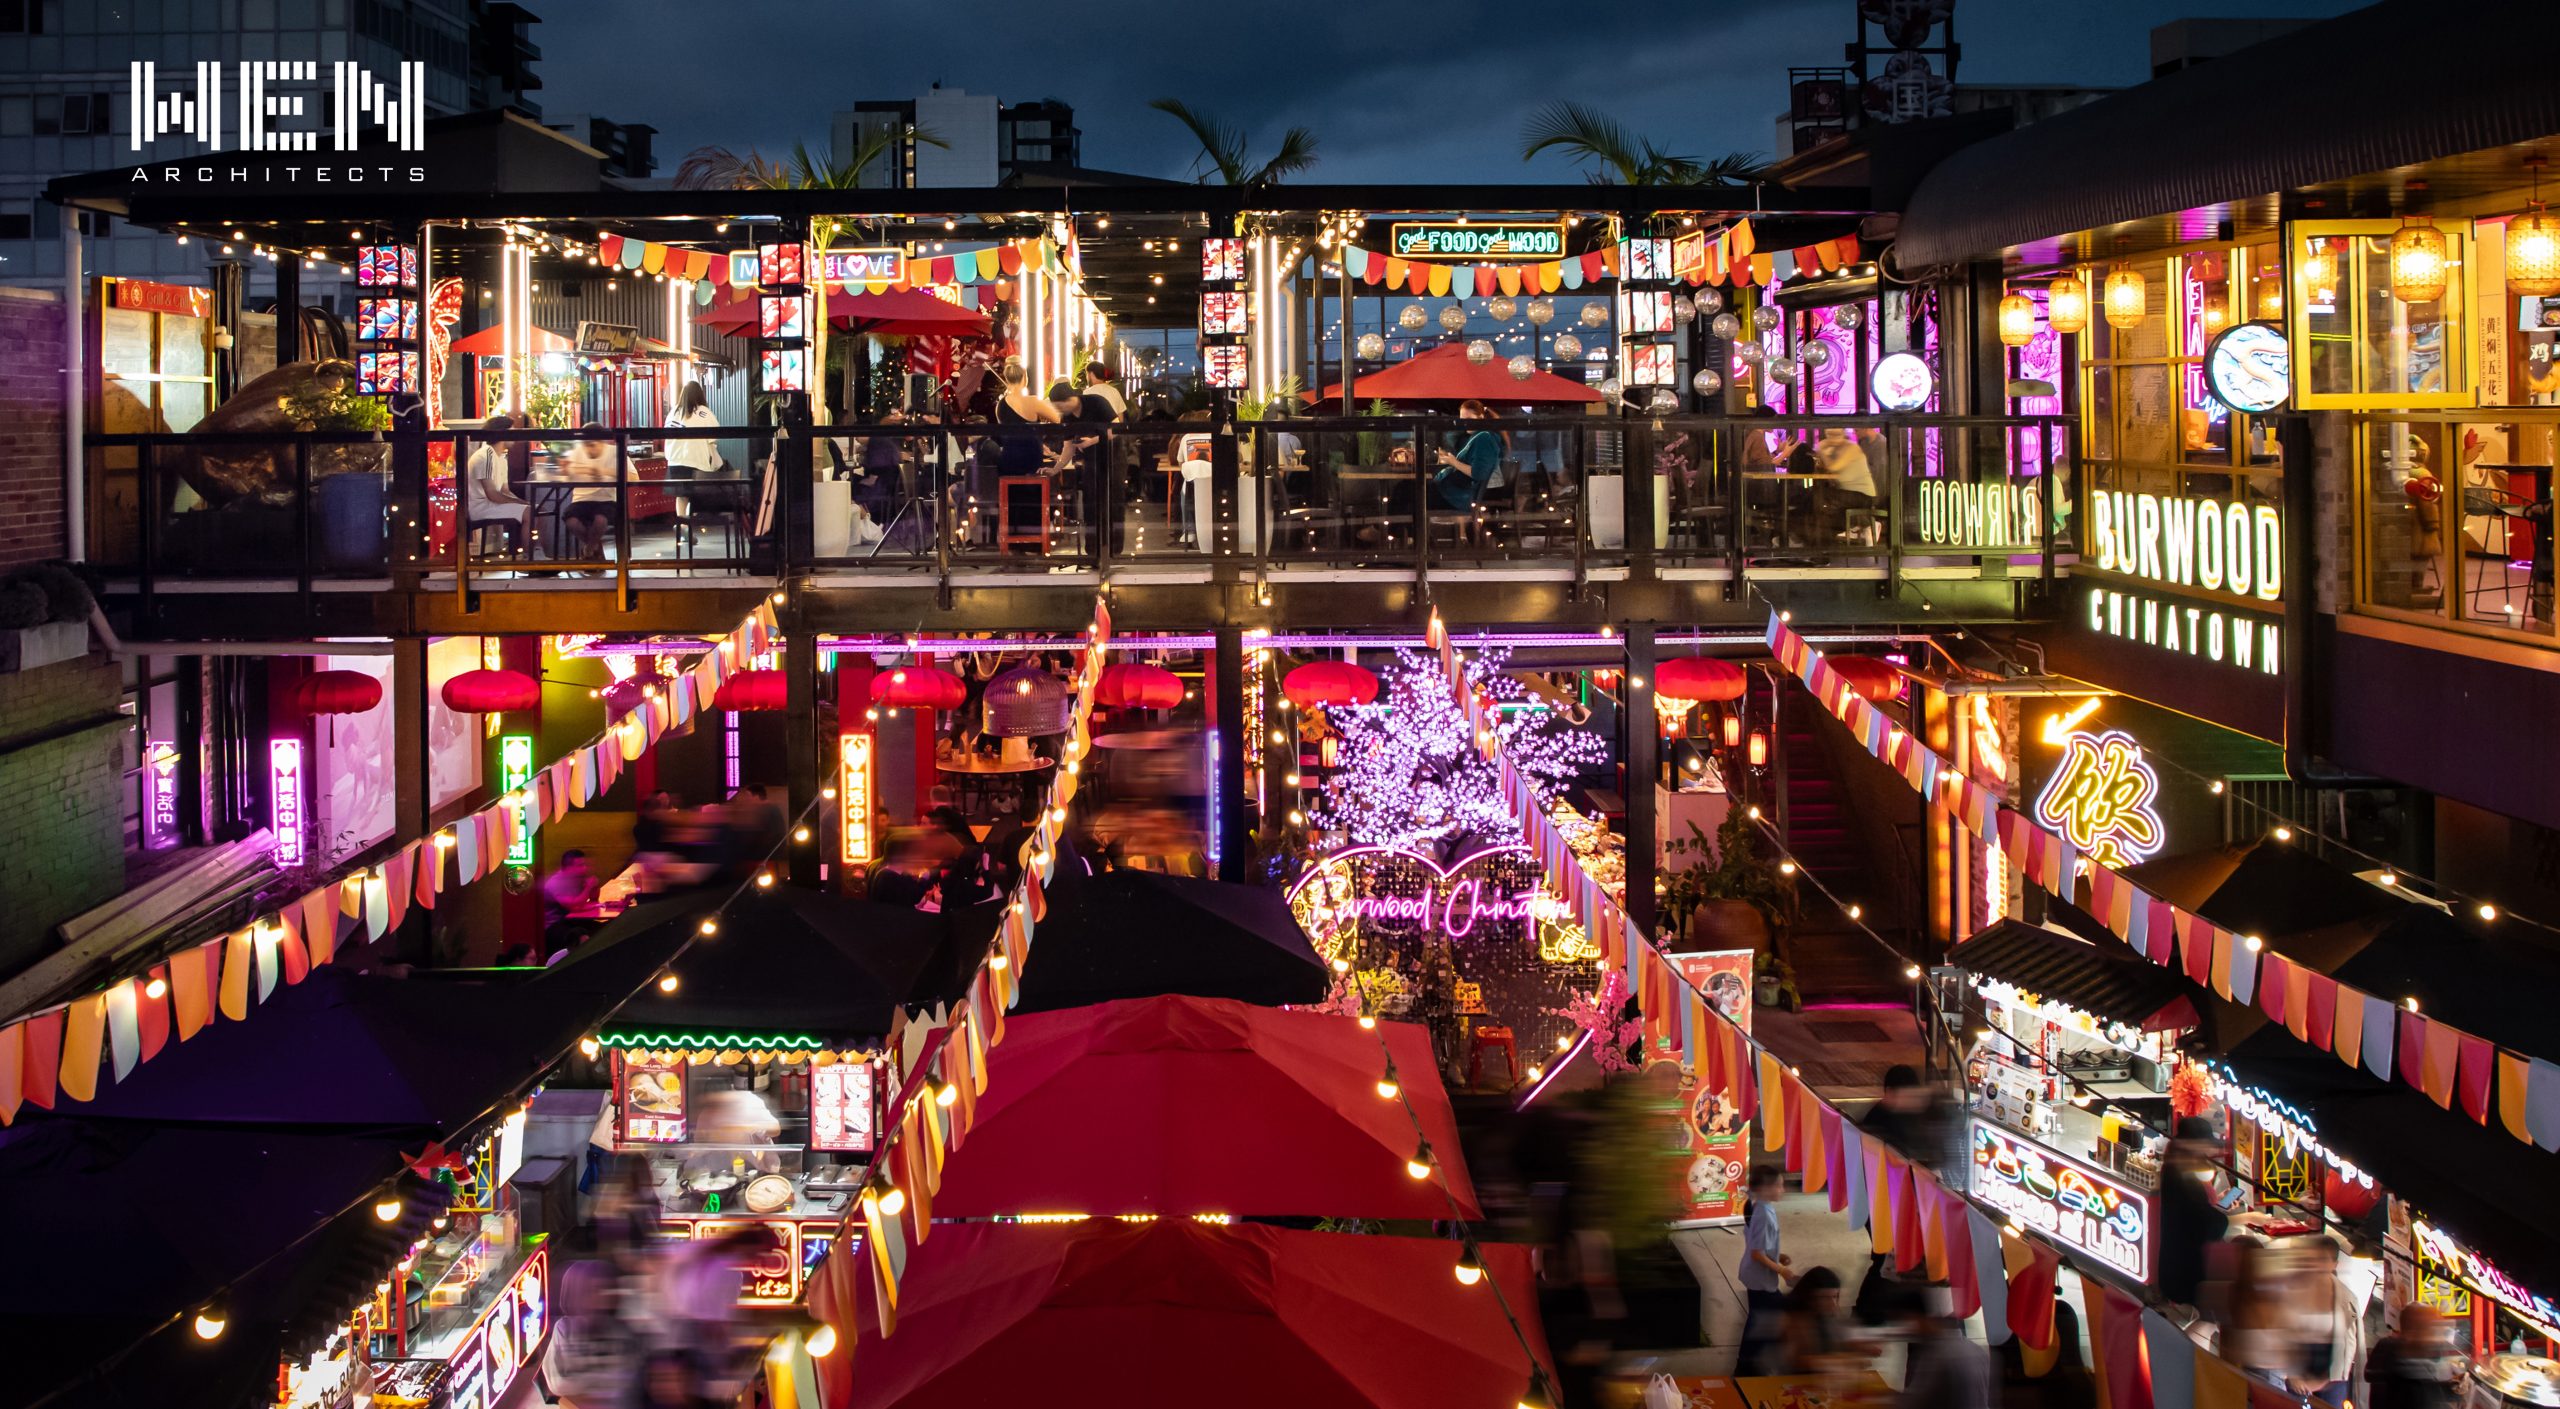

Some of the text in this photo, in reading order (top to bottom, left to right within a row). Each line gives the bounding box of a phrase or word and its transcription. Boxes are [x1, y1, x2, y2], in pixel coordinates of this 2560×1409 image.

[1428, 231, 1477, 253] FOOD
[1508, 231, 1559, 253] MOOD
[2093, 489, 2282, 601] BURWOOD
[2091, 588, 2279, 676] CHINATOWN
[1974, 1162, 2140, 1274] House of Lim
